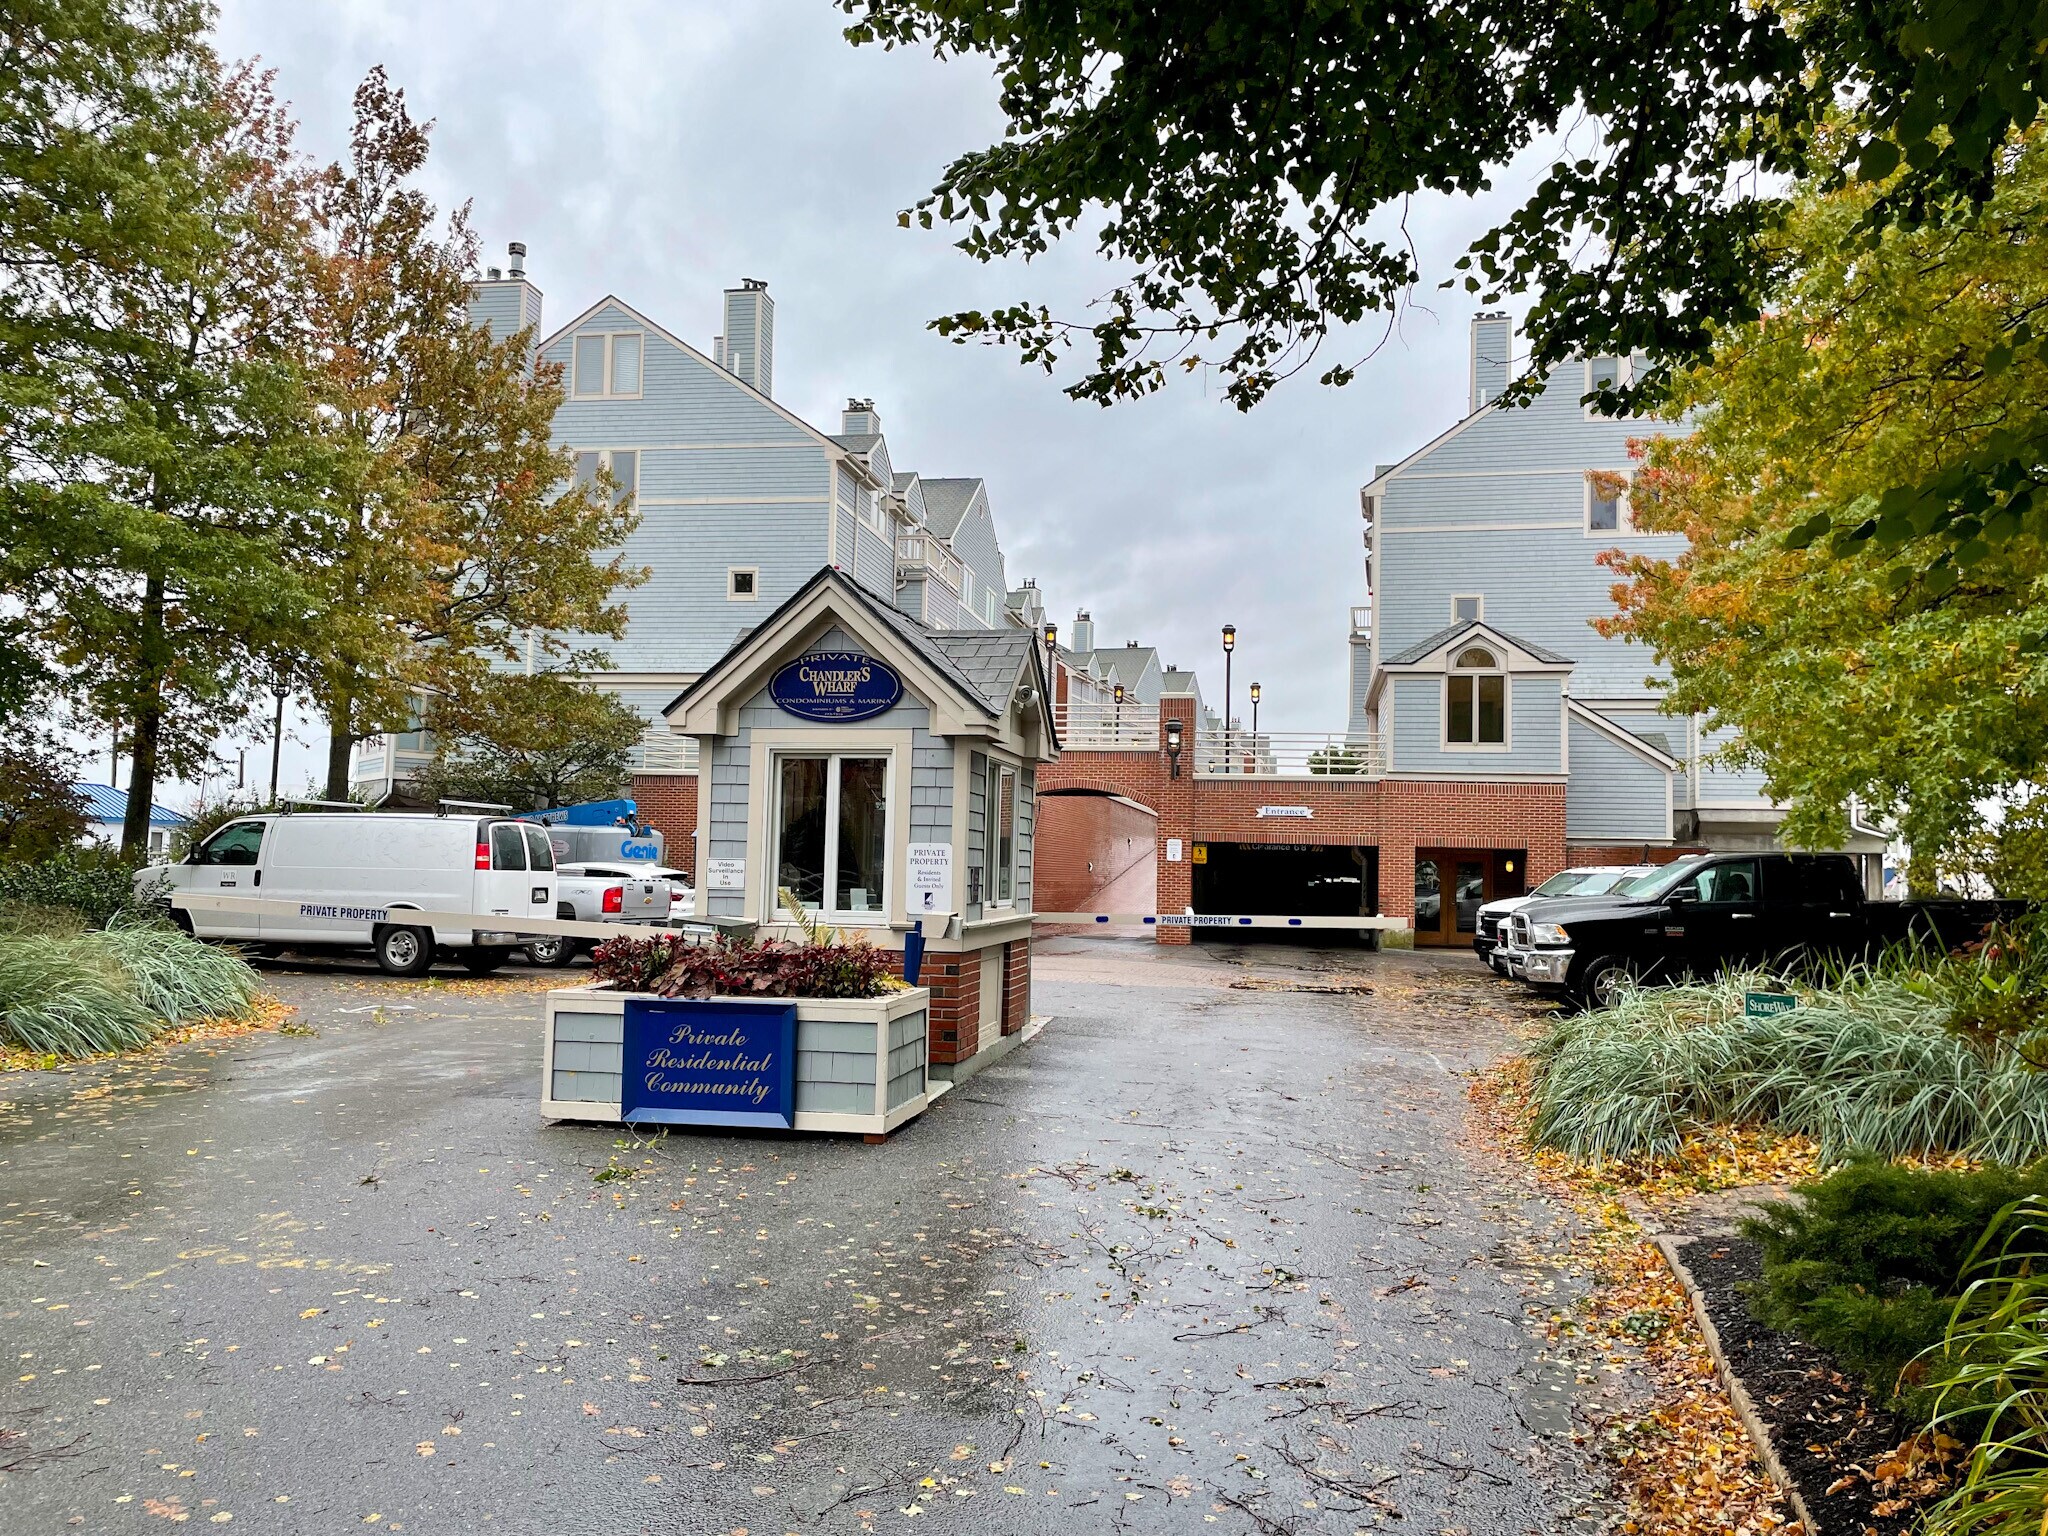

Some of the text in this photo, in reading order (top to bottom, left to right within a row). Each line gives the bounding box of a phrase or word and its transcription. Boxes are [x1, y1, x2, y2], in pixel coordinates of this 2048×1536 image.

[800, 654, 871, 665] PRIVATE
[799, 667, 871, 682] CHANDLER'S
[813, 681, 857, 696] WHARF
[1265, 807, 1305, 815] Entrance
[621, 840, 658, 860] Genie
[914, 849, 946, 857] PRIVATE
[300, 904, 388, 920] PRIVATE PROPERTY
[1161, 916, 1232, 925] PRIVATE PROPERTY
[668, 1023, 750, 1046] Private
[646, 1047, 772, 1072] Residential
[644, 1071, 774, 1105] Community
